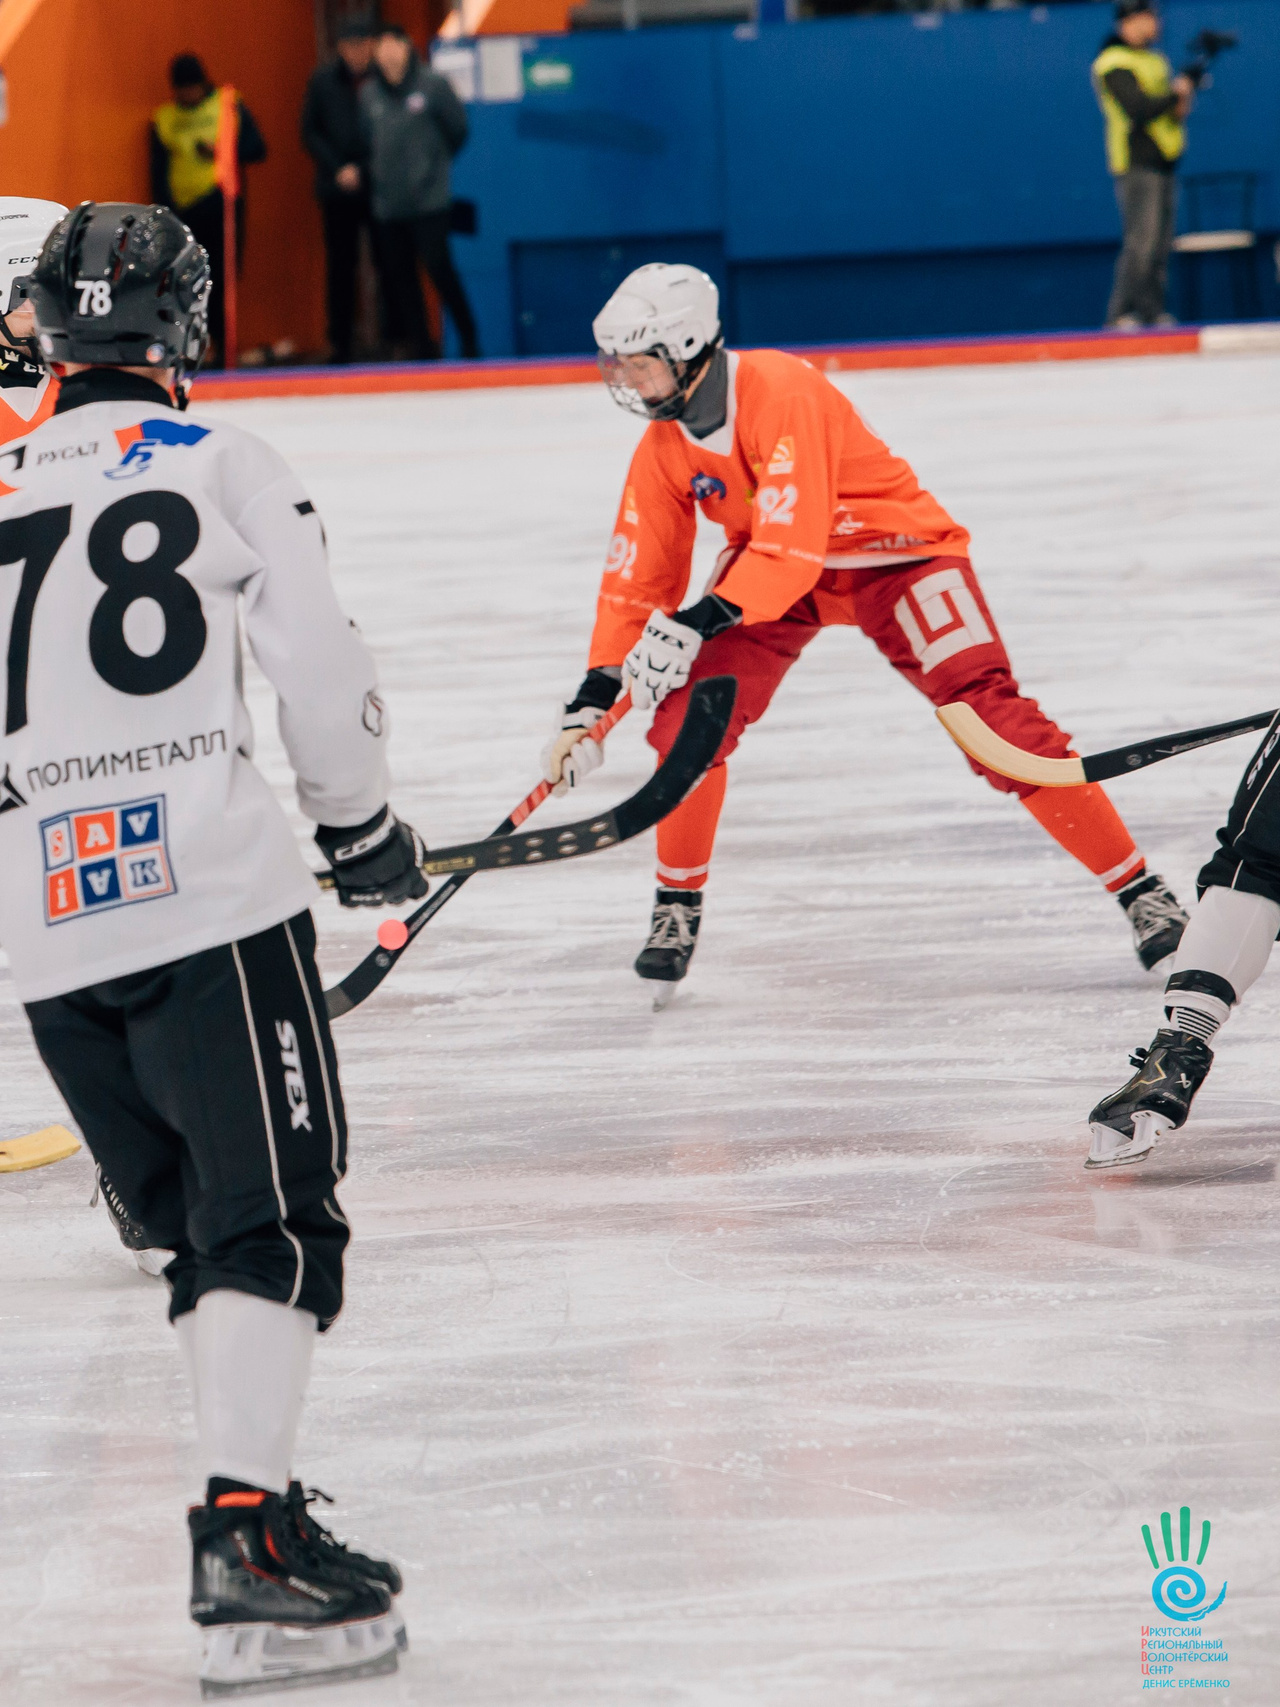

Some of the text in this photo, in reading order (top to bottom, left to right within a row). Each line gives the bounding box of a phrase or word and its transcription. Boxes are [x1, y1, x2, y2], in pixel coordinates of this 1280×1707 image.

[75, 280, 112, 315] 78
[37, 441, 99, 465] РУСАЛ
[647, 626, 691, 651] STEX
[26, 729, 227, 793] ПОЛИМЕТАЛЛ
[1246, 724, 1280, 790] STE
[275, 1019, 313, 1133] STEX
